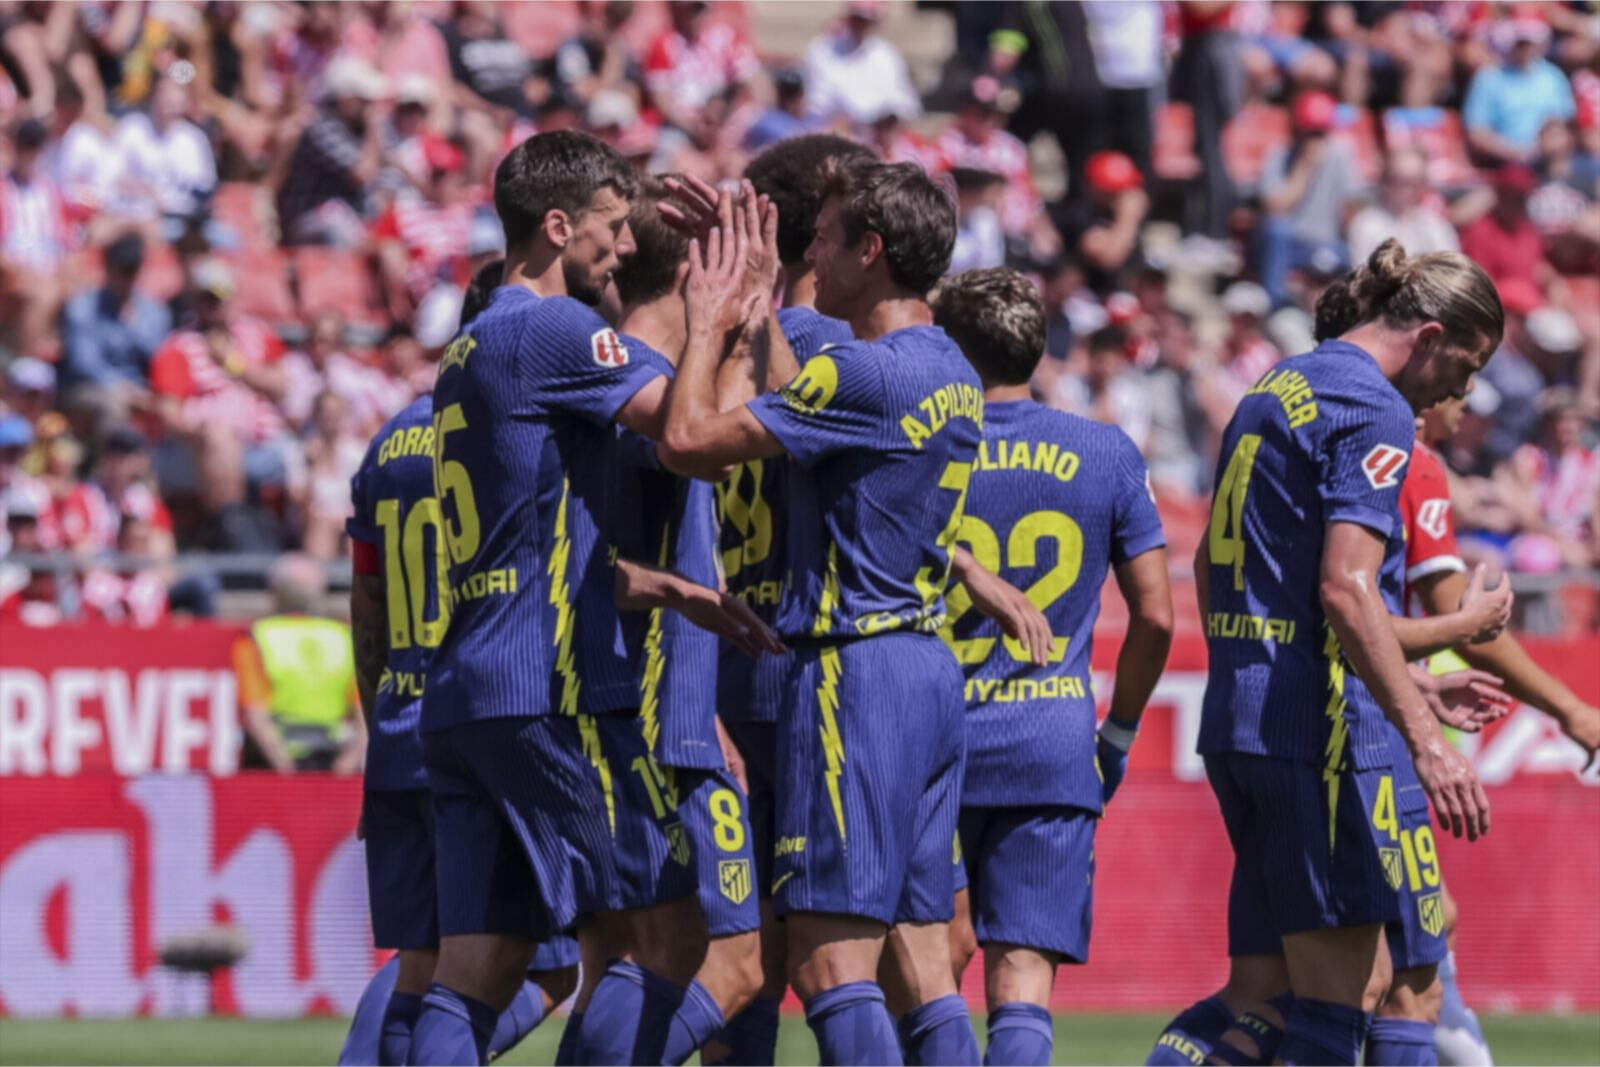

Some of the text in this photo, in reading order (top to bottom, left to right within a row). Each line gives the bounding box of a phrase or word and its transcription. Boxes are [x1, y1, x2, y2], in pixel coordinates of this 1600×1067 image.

[971, 439, 1080, 483] LIANO
[1209, 433, 1263, 590] 4
[375, 497, 451, 650] 10
[708, 788, 745, 852] 8
[1372, 775, 1399, 841] 4
[1400, 824, 1441, 892] 19
